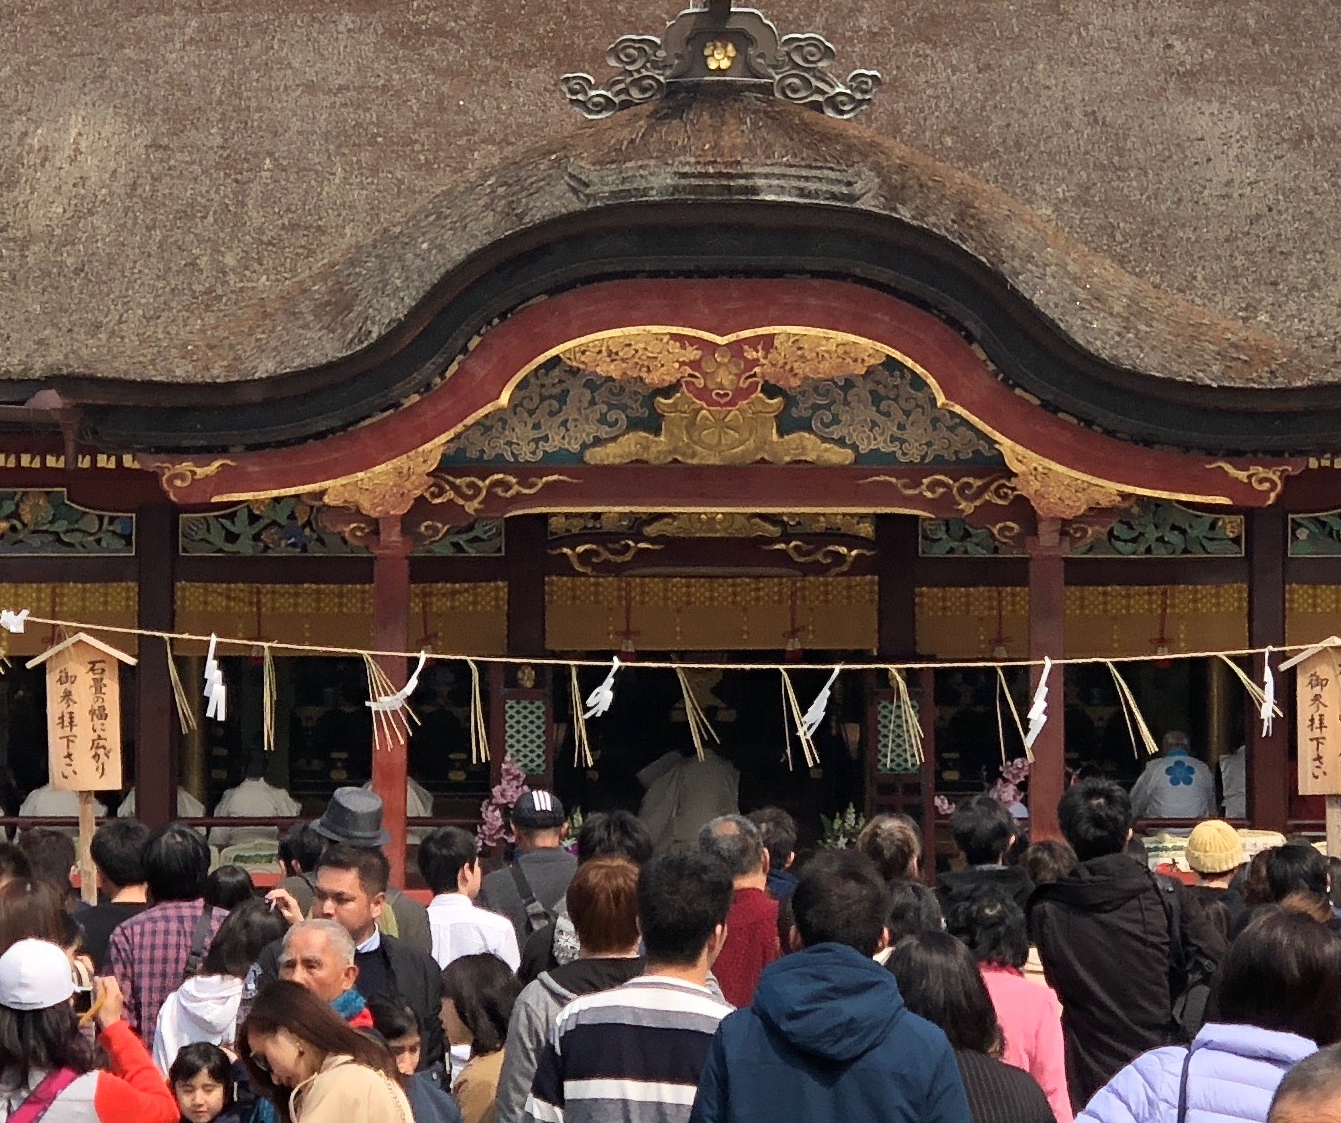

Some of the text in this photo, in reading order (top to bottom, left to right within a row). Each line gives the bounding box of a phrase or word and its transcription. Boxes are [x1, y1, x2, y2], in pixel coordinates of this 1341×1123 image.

[56, 667, 78, 780] 御参拝下さい
[85, 659, 112, 780] 石畳の幅に広がり
[1305, 671, 1329, 780] 御参拝下さい
